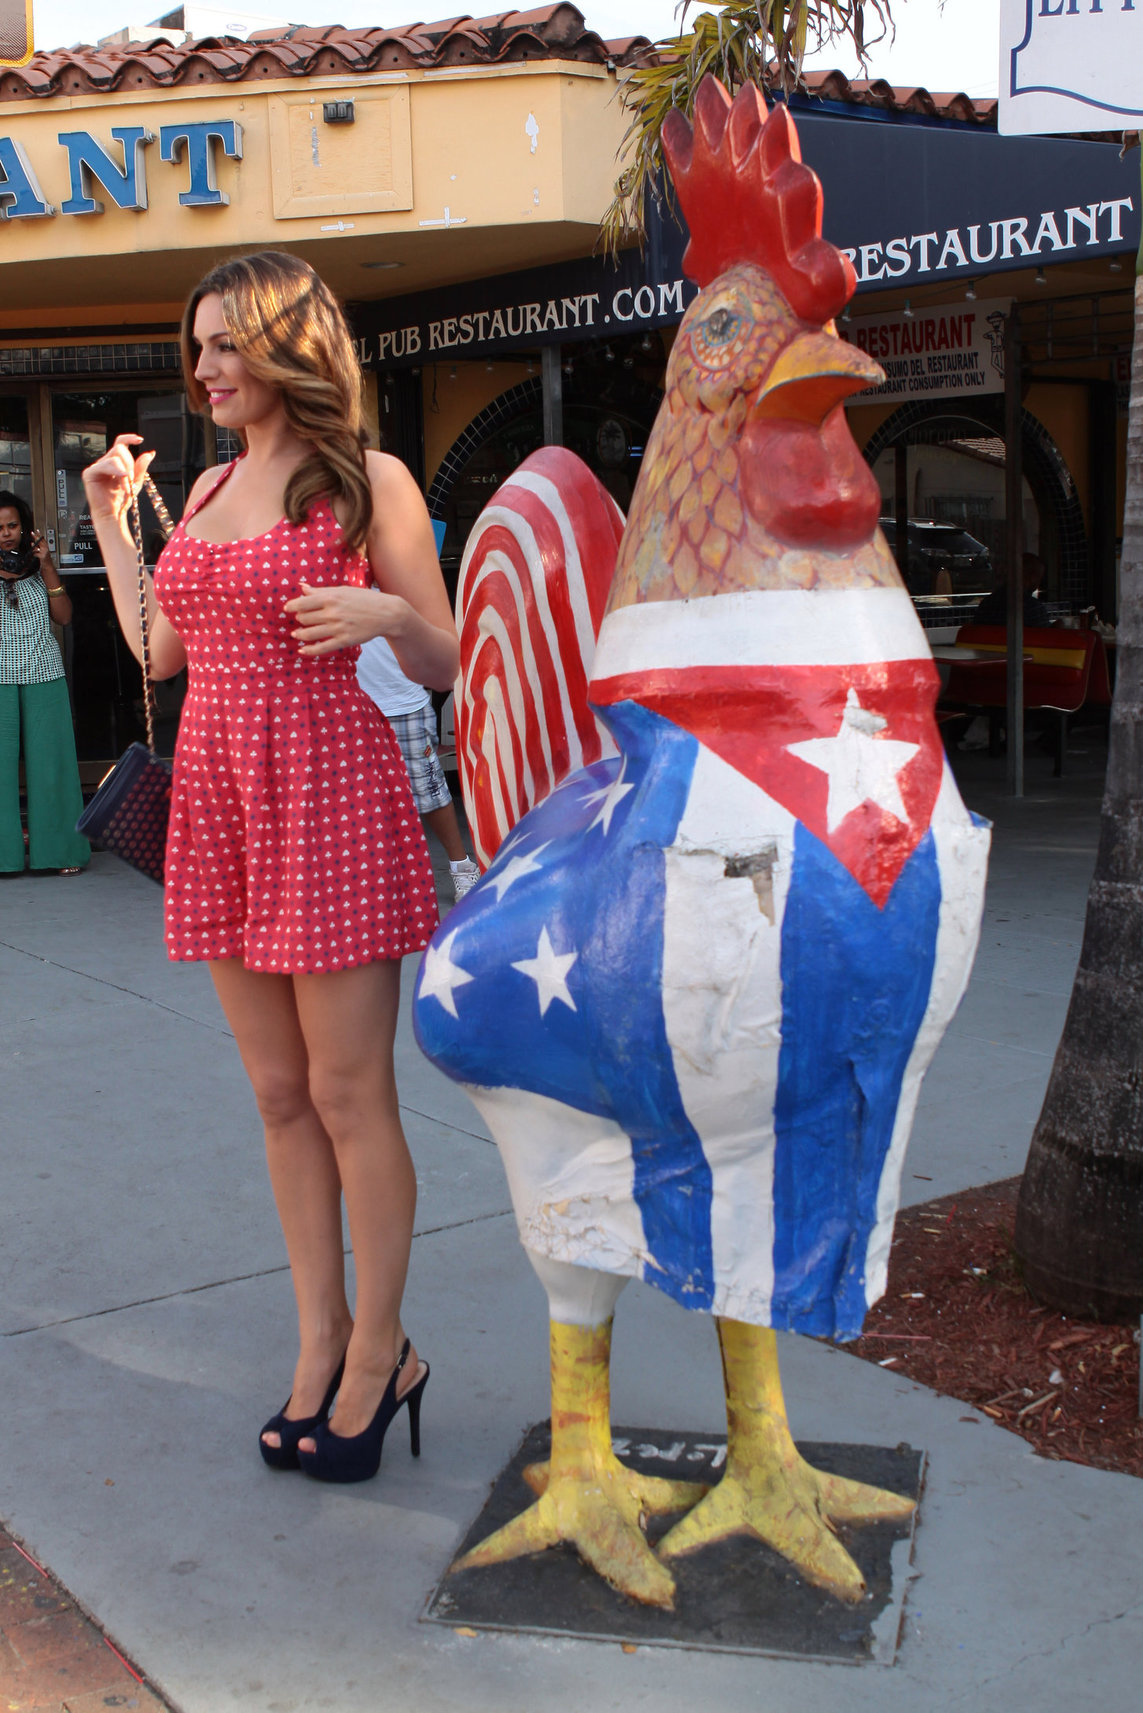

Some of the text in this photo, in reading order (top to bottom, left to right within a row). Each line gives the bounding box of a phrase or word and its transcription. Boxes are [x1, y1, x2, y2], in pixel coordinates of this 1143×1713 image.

[378, 326, 422, 361] PUB
[856, 313, 976, 358] RESTAURANT
[910, 358, 925, 376] DEL
[928, 352, 979, 374] RESTAURANT
[909, 373, 963, 393] CONSUMPTION
[965, 371, 986, 387] ONLY
[74, 542, 93, 550] PULL
